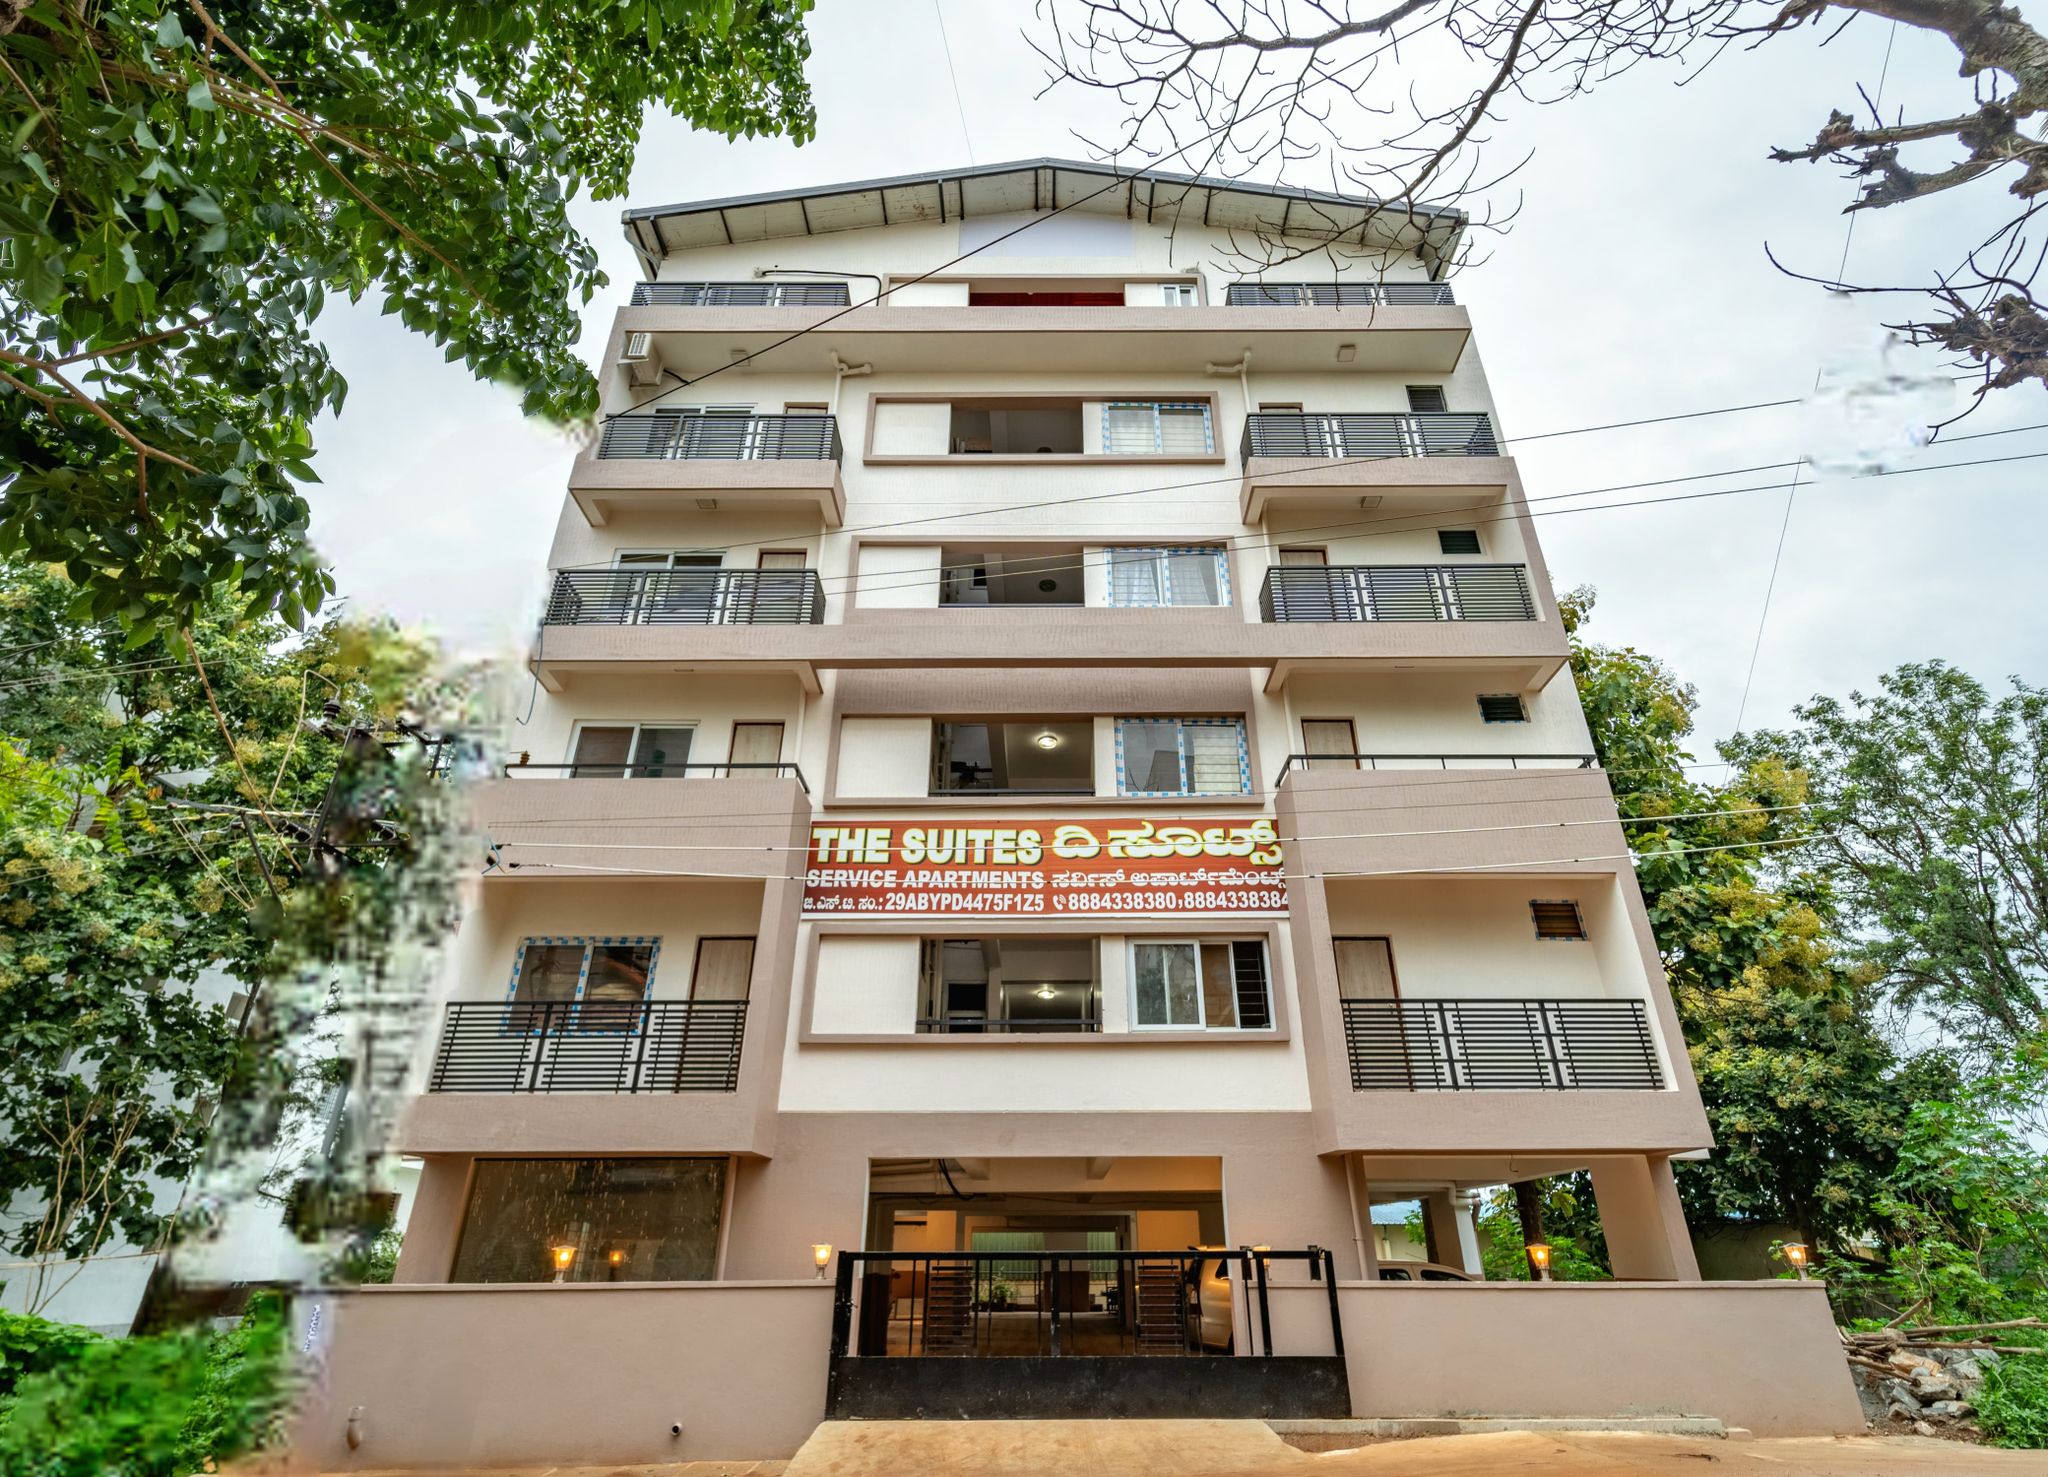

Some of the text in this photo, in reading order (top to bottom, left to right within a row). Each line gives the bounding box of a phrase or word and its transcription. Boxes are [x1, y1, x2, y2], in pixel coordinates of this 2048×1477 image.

[812, 828, 1044, 865] THE SUITES
[1052, 824, 1101, 858] ದಿ
[806, 869, 1045, 889] SERVICE APARTMENTS
[885, 893, 1044, 911] 29ABYPD4475F1Z5
